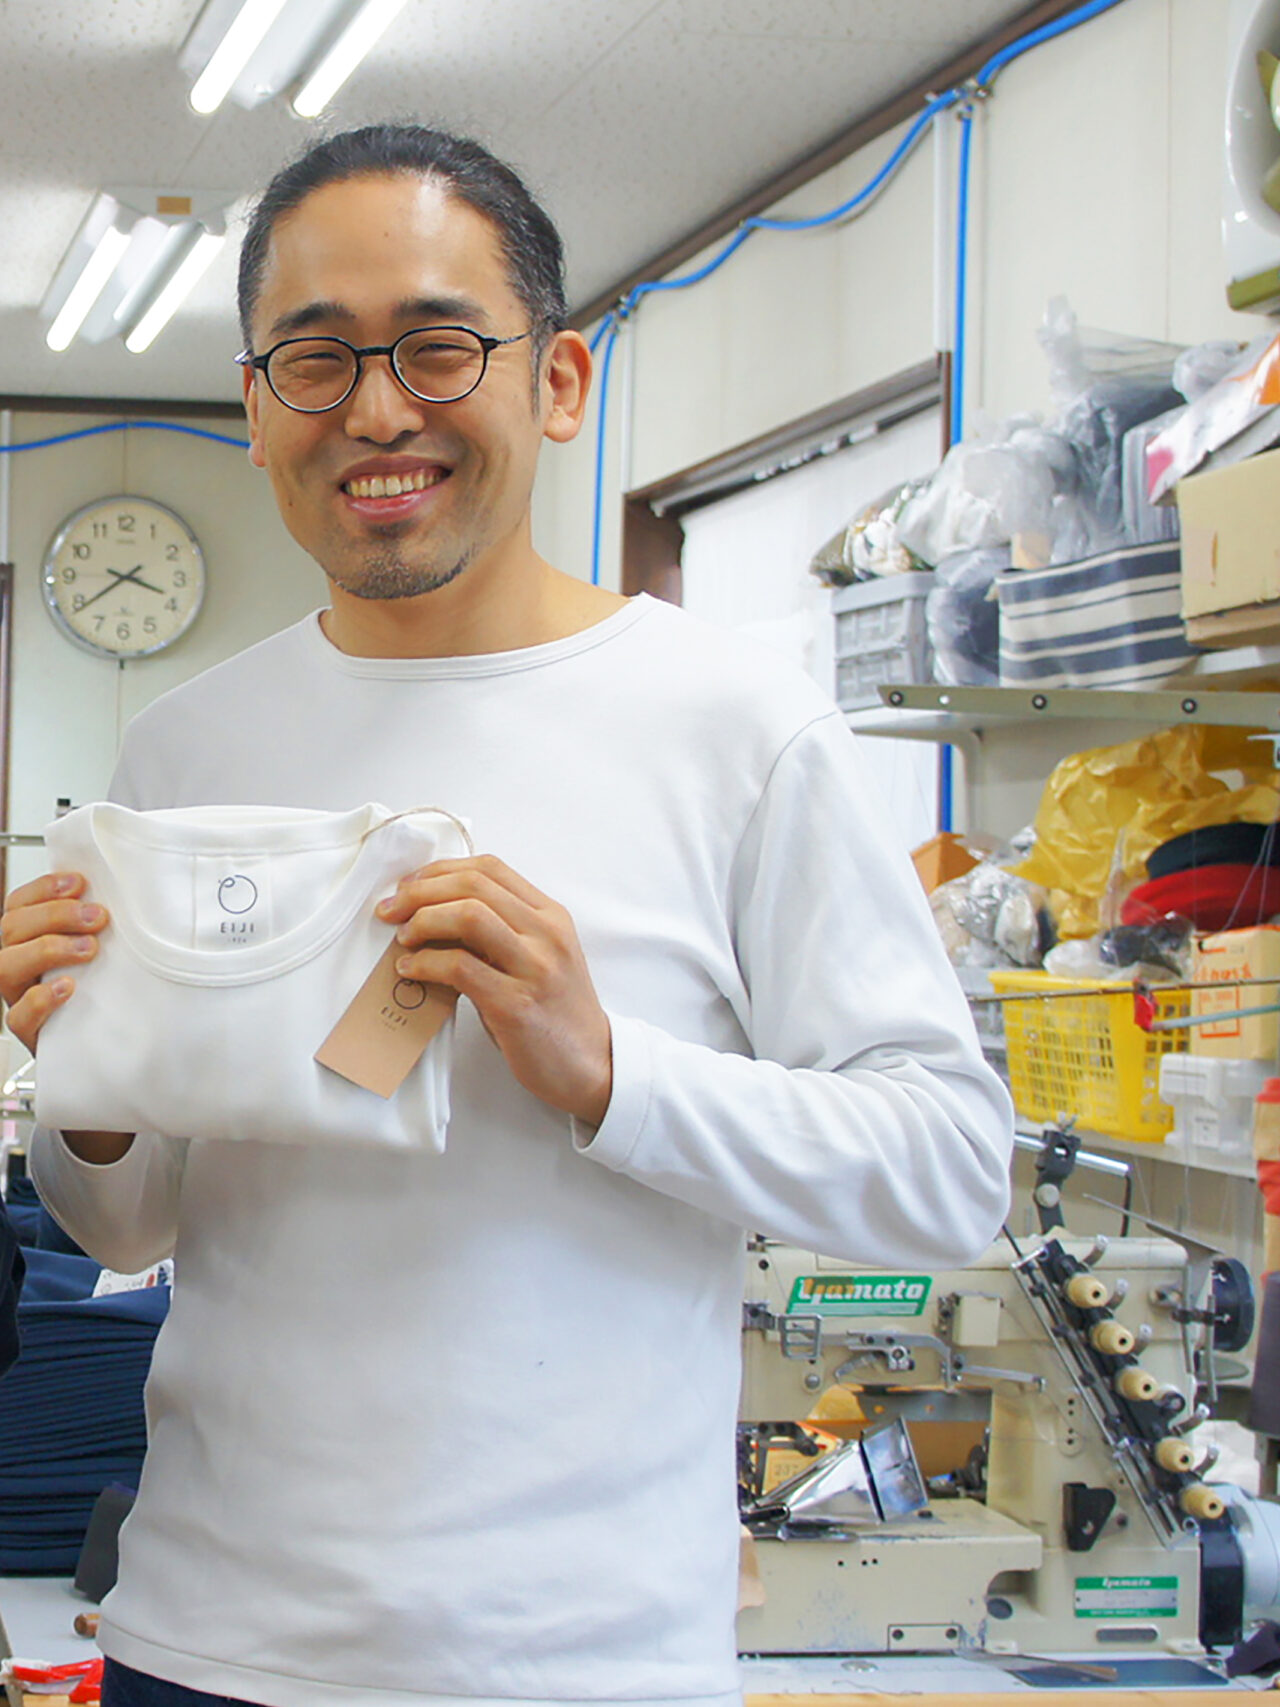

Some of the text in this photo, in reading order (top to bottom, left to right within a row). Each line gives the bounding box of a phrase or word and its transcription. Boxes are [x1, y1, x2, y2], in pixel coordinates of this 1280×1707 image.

[93, 523, 108, 539] 11
[117, 515, 136, 532] 12
[149, 523, 156, 539] 1
[72, 543, 91, 560] 10
[166, 544, 179, 561] 2
[62, 567, 76, 584] 9
[173, 570, 186, 588] 3
[72, 594, 86, 611] 8
[164, 598, 178, 612] 4
[92, 615, 106, 632] 7
[117, 623, 131, 640] 6
[143, 616, 157, 633] 5
[220, 921, 254, 934] EIJI
